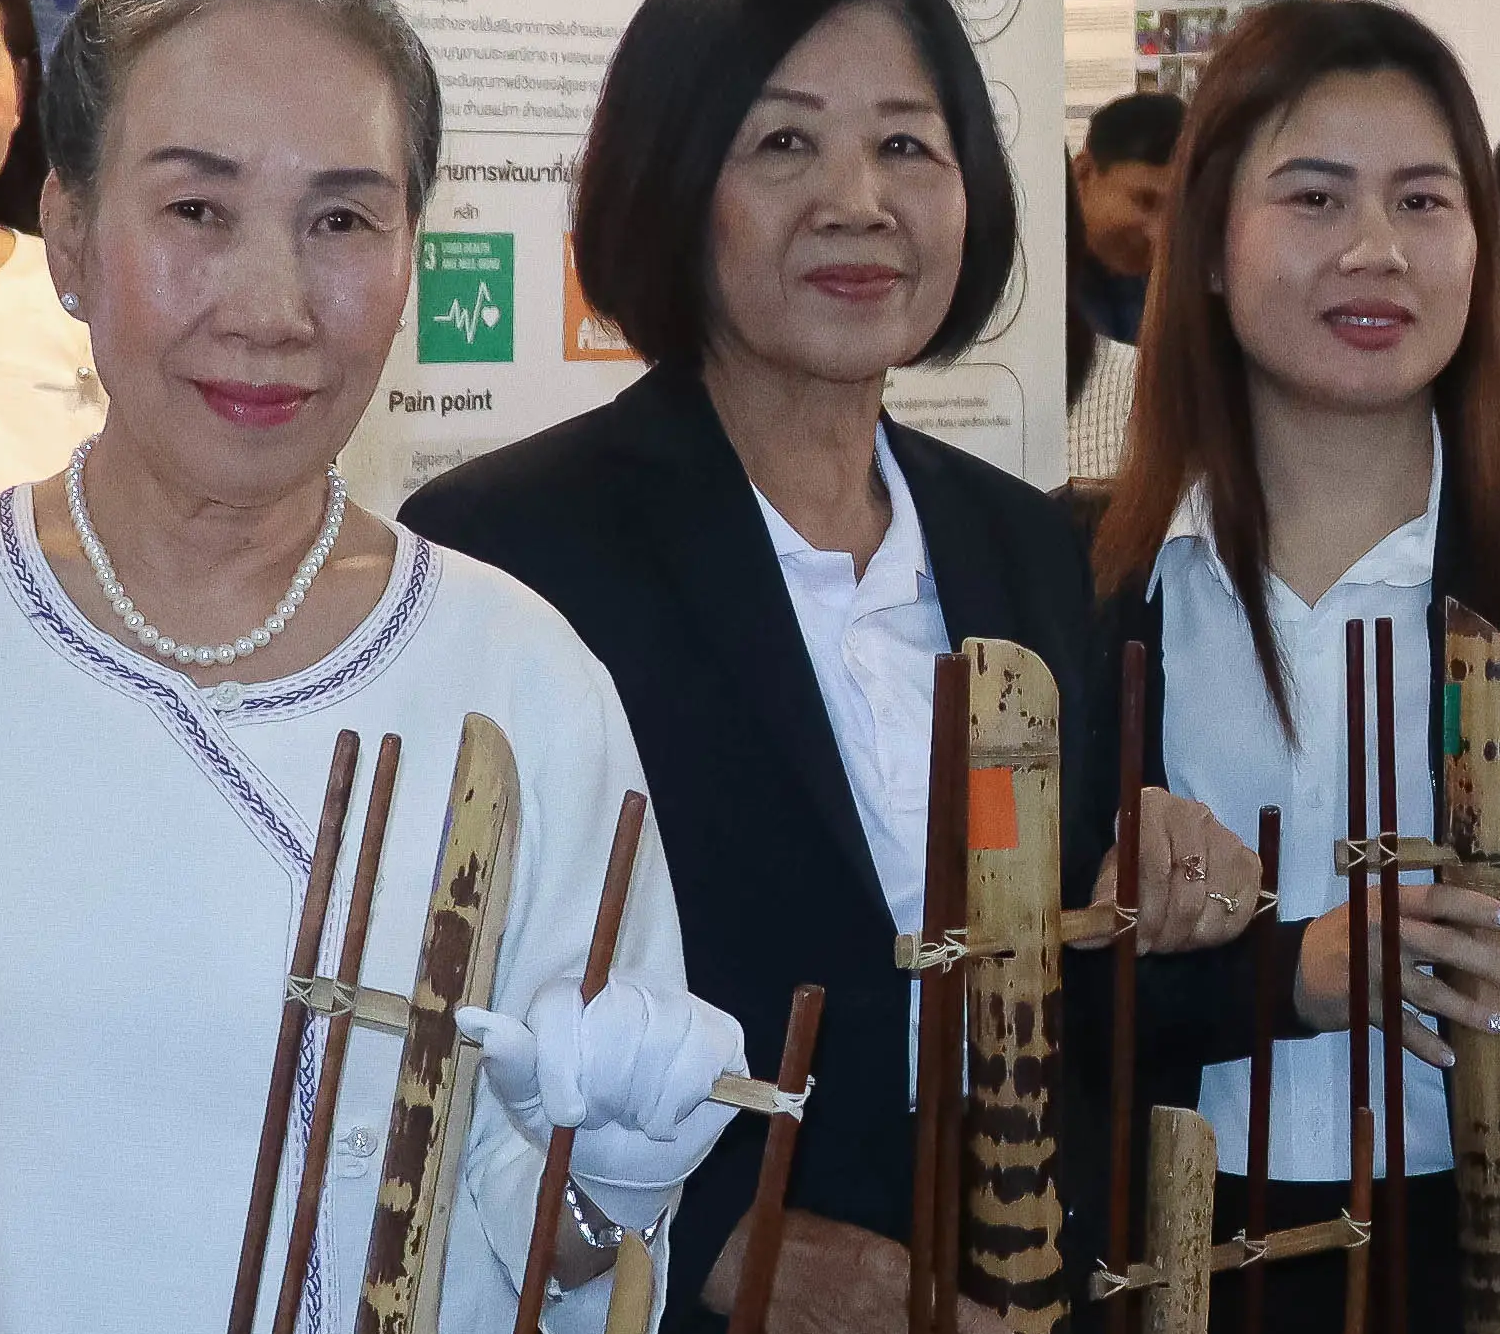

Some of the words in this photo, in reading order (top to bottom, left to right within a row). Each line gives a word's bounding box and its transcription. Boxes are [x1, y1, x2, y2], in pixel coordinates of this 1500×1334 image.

[423, 241, 436, 272] 3
[388, 390, 435, 413] Pain
[440, 388, 493, 417] point
